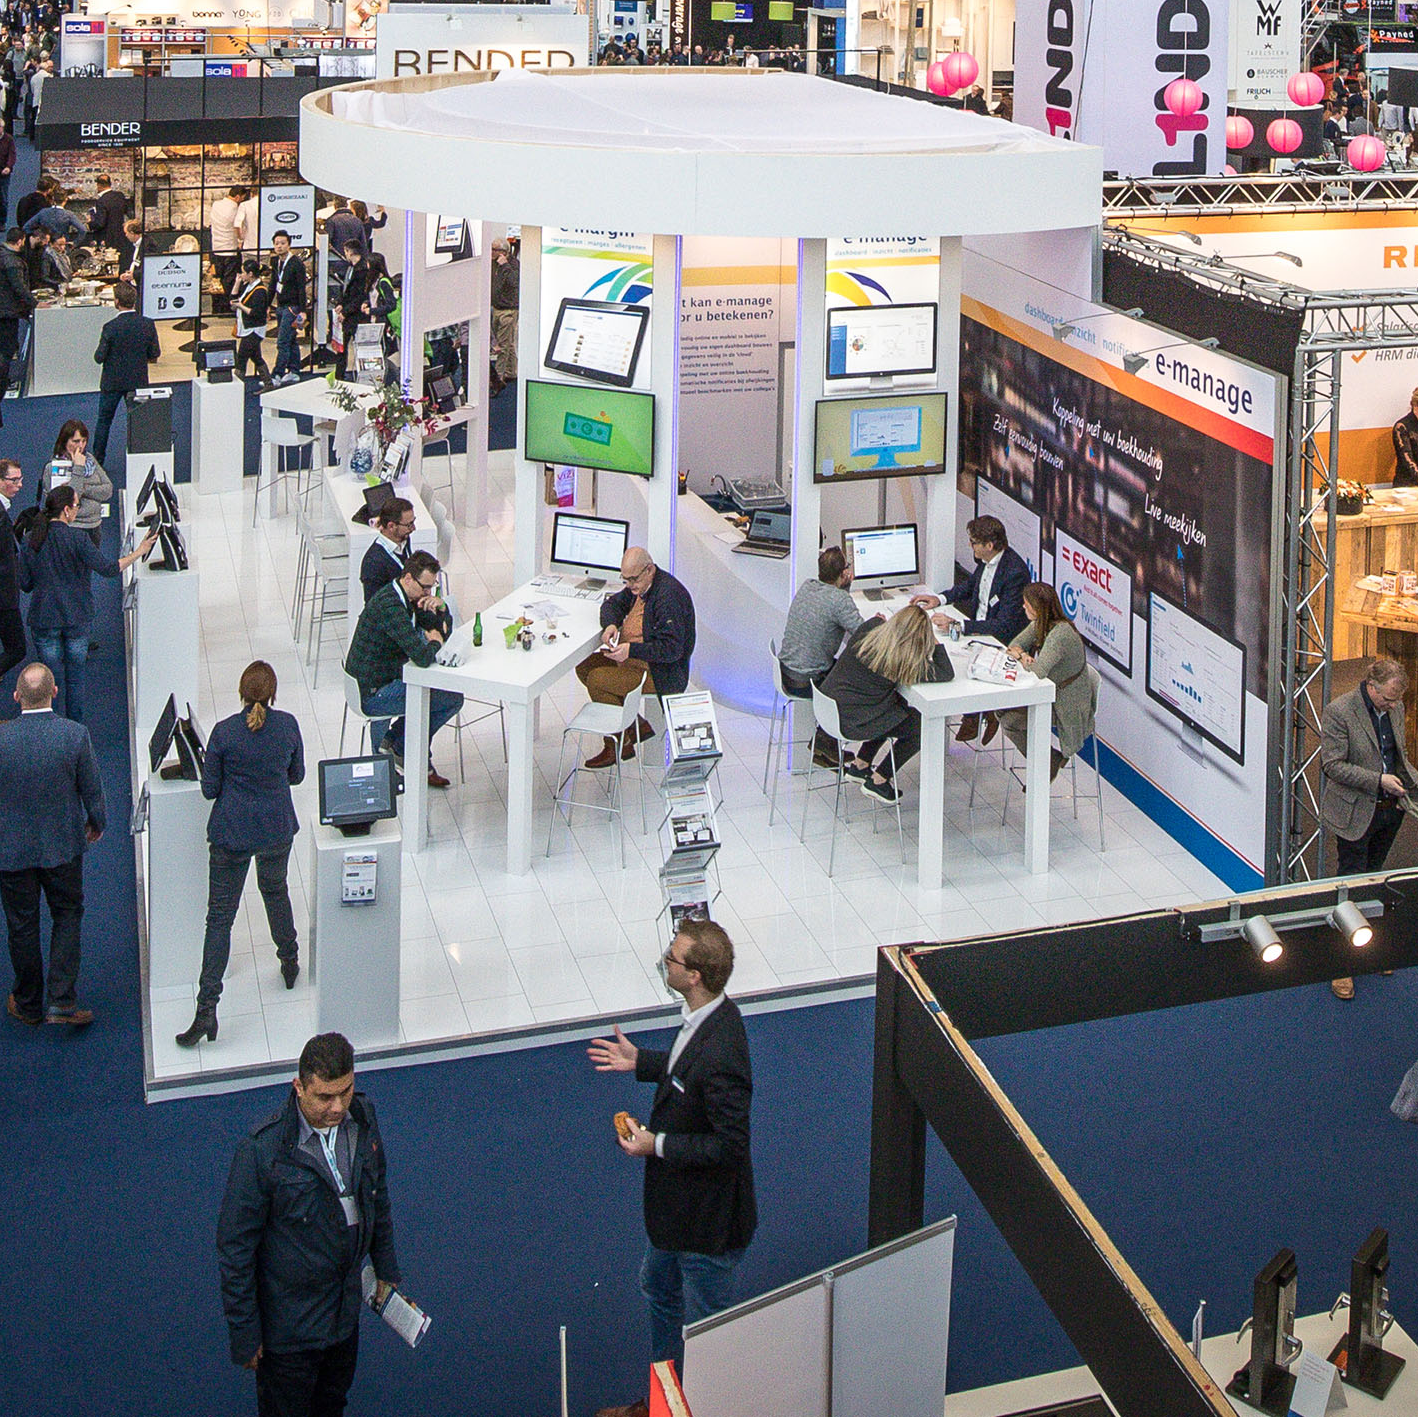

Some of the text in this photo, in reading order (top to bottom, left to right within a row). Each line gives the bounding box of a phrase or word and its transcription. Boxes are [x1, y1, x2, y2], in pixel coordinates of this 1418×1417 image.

[232, 8, 261, 19] YONG
[1256, 0, 1282, 36] WMF
[66, 22, 92, 33] sola
[1379, 30, 1414, 39] Payned
[205, 66, 232, 77] sola
[81, 122, 141, 136] BENDER
[691, 297, 712, 308] kan
[695, 309, 774, 322] u betekenen?
[1025, 302, 1063, 328] dashboard
[1375, 349, 1403, 361] HRM
[1155, 353, 1253, 415] e-manage
[993, 414, 1064, 471] Zelf eenvoudig bouwen
[1053, 397, 1163, 481] Koppeling met uw boekhouding
[1145, 493, 1207, 547] Live meekijken
[1073, 551, 1112, 593] exact
[1080, 602, 1116, 642] Twinfield
